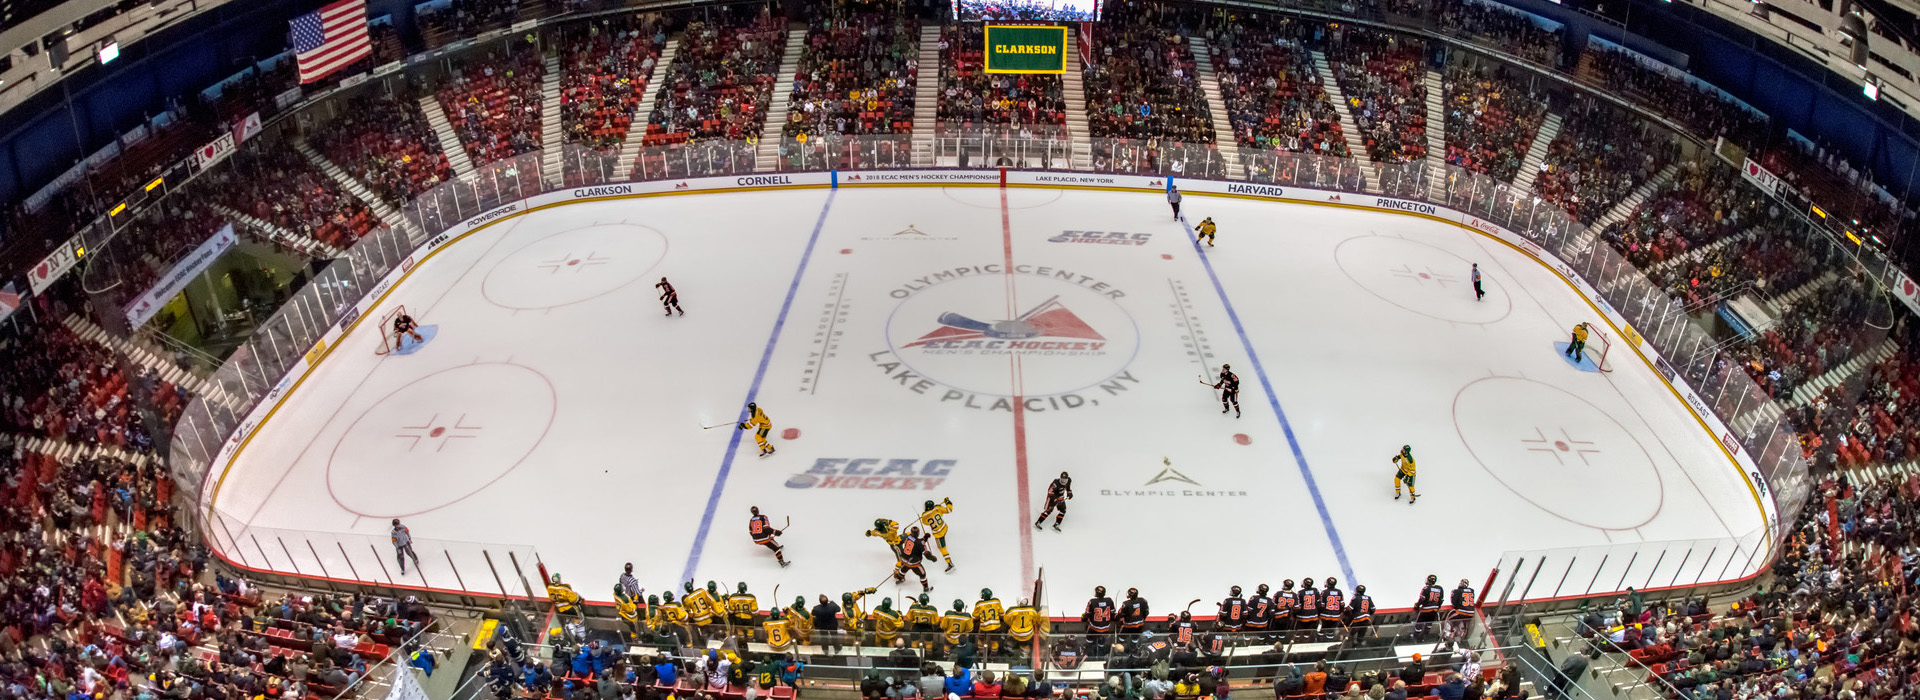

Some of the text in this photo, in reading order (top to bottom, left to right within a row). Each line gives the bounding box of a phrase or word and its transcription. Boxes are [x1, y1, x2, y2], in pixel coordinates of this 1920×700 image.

[996, 44, 1056, 54] CLARKSON
[199, 150, 205, 163] I
[214, 134, 232, 154] NY
[737, 175, 792, 186] CORNELL
[1744, 160, 1776, 188] I NY
[574, 185, 632, 198] CLARKSON
[1228, 183, 1283, 197] HARVARD
[1376, 198, 1436, 215] PRINCETON
[467, 204, 517, 228] POWERADE
[1058, 230, 1152, 241] ECAC
[29, 272, 38, 286] I
[48, 245, 70, 271] NY
[154, 250, 213, 300] Welcome ECAC Hockey Fans
[890, 264, 1126, 300] OLYMPIC CENTER
[371, 280, 390, 300] BOXCAST
[920, 340, 1106, 350] ECAC HOCKEY
[868, 350, 1141, 414] LAKE PLACID, NY
[1687, 392, 1710, 418] BOXCAST
[805, 458, 958, 476] ECAC
[817, 476, 946, 490] HOCKEY
[1100, 489, 1177, 497] OLYMPIC
[927, 514, 944, 530] 28
[693, 597, 708, 613] 19
[1304, 595, 1316, 610] 21
[1326, 596, 1340, 610] 25
[1462, 592, 1474, 606] 35
[1132, 607, 1140, 616] 4
[1231, 605, 1241, 619] 8
[1257, 603, 1267, 617] 7
[1360, 600, 1369, 613] 9
[982, 608, 996, 622] 13
[1094, 606, 1110, 622] 24
[953, 622, 960, 633] 3
[1021, 616, 1025, 628] 1
[772, 629, 782, 642] 6
[1178, 627, 1192, 642] 16
[1211, 640, 1223, 653] 11
[735, 669, 742, 678] 3
[760, 673, 771, 684] 12
